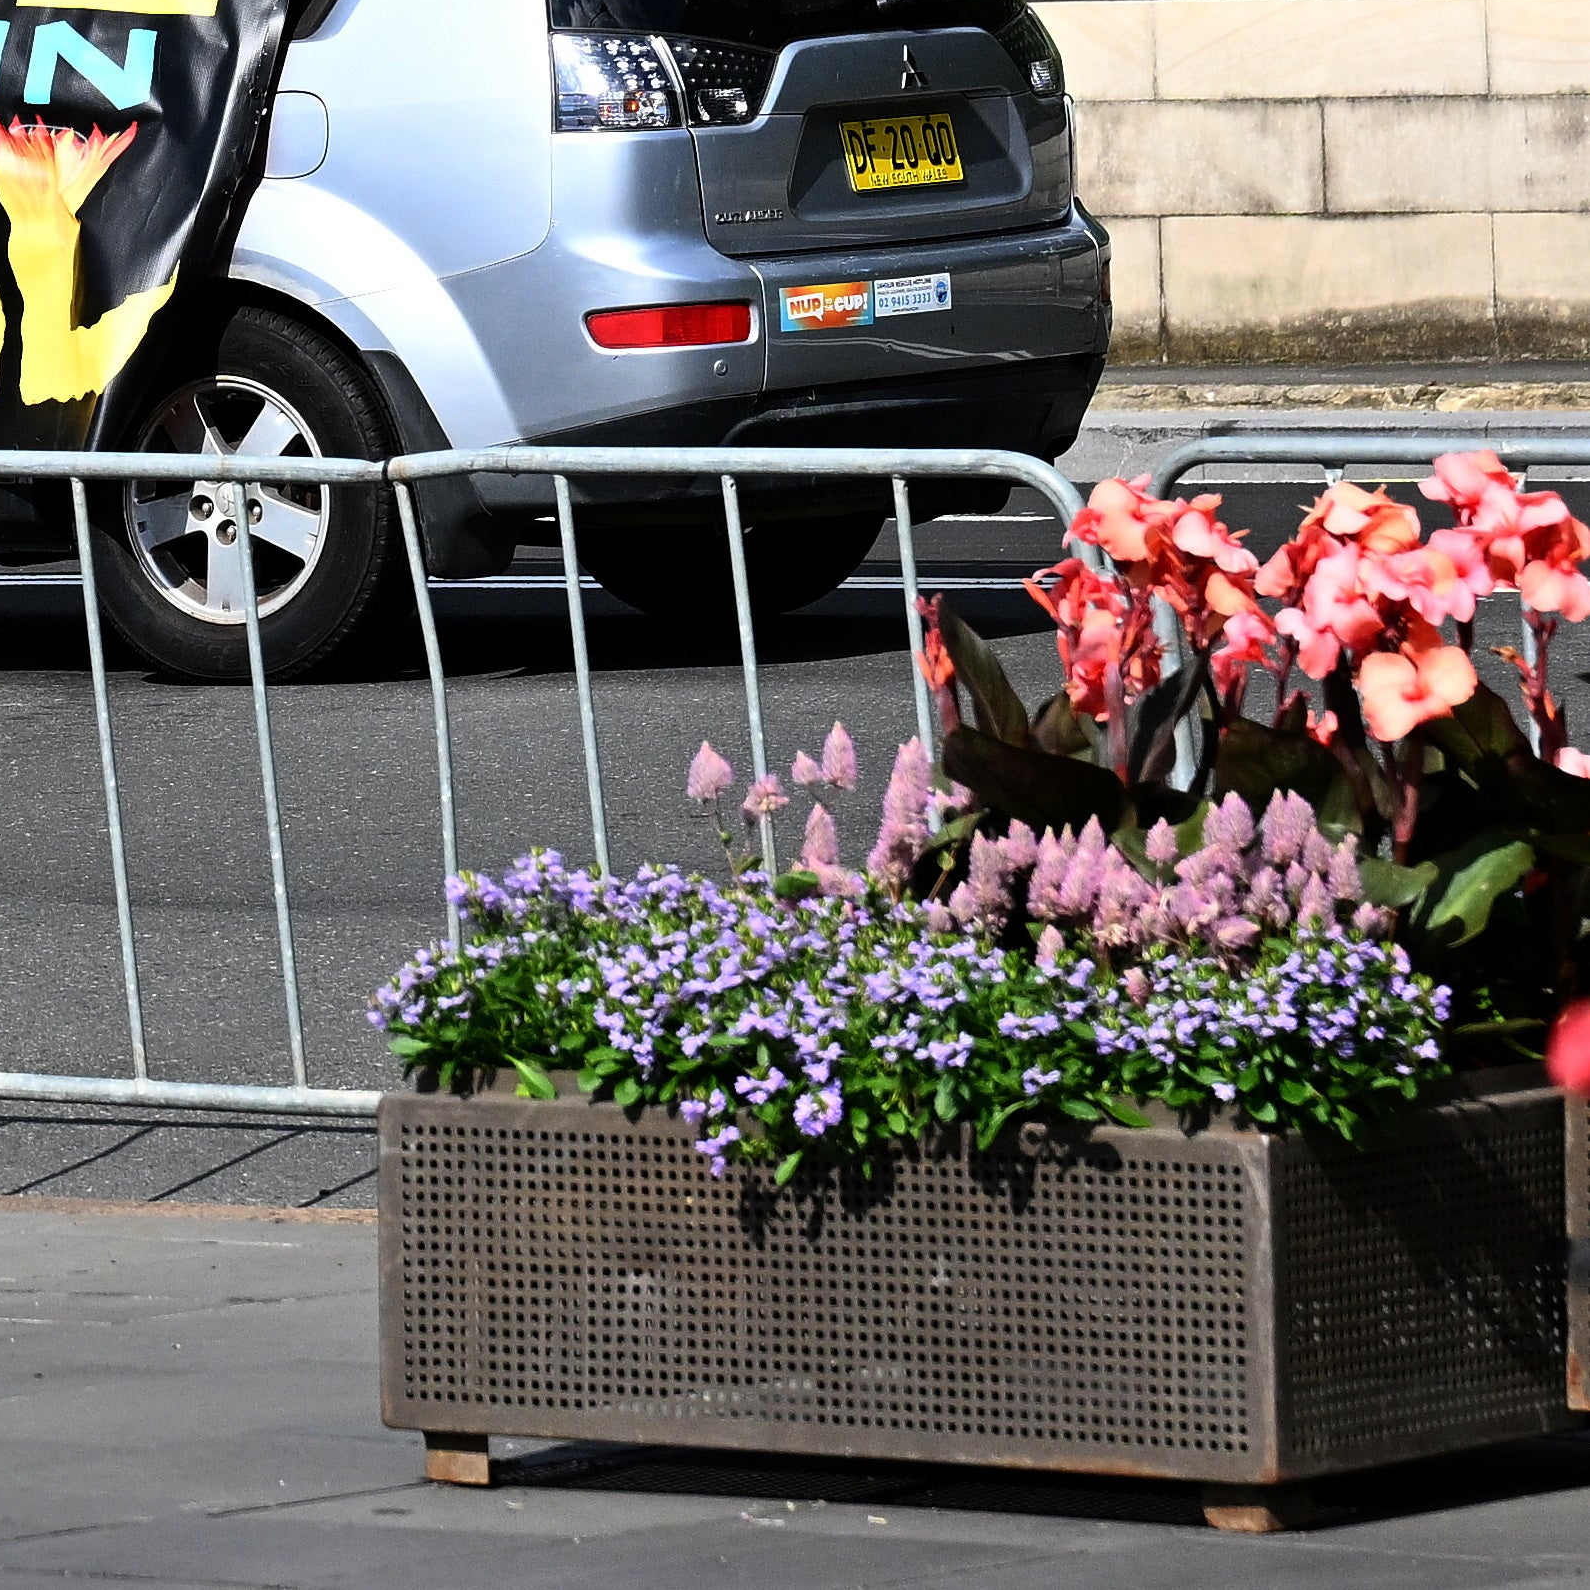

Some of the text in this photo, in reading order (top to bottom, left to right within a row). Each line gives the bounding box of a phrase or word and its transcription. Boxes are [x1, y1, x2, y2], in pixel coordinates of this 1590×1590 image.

[789, 297, 821, 316] NUP
[834, 292, 868, 313] CUP!
[878, 297, 889, 308] 02
